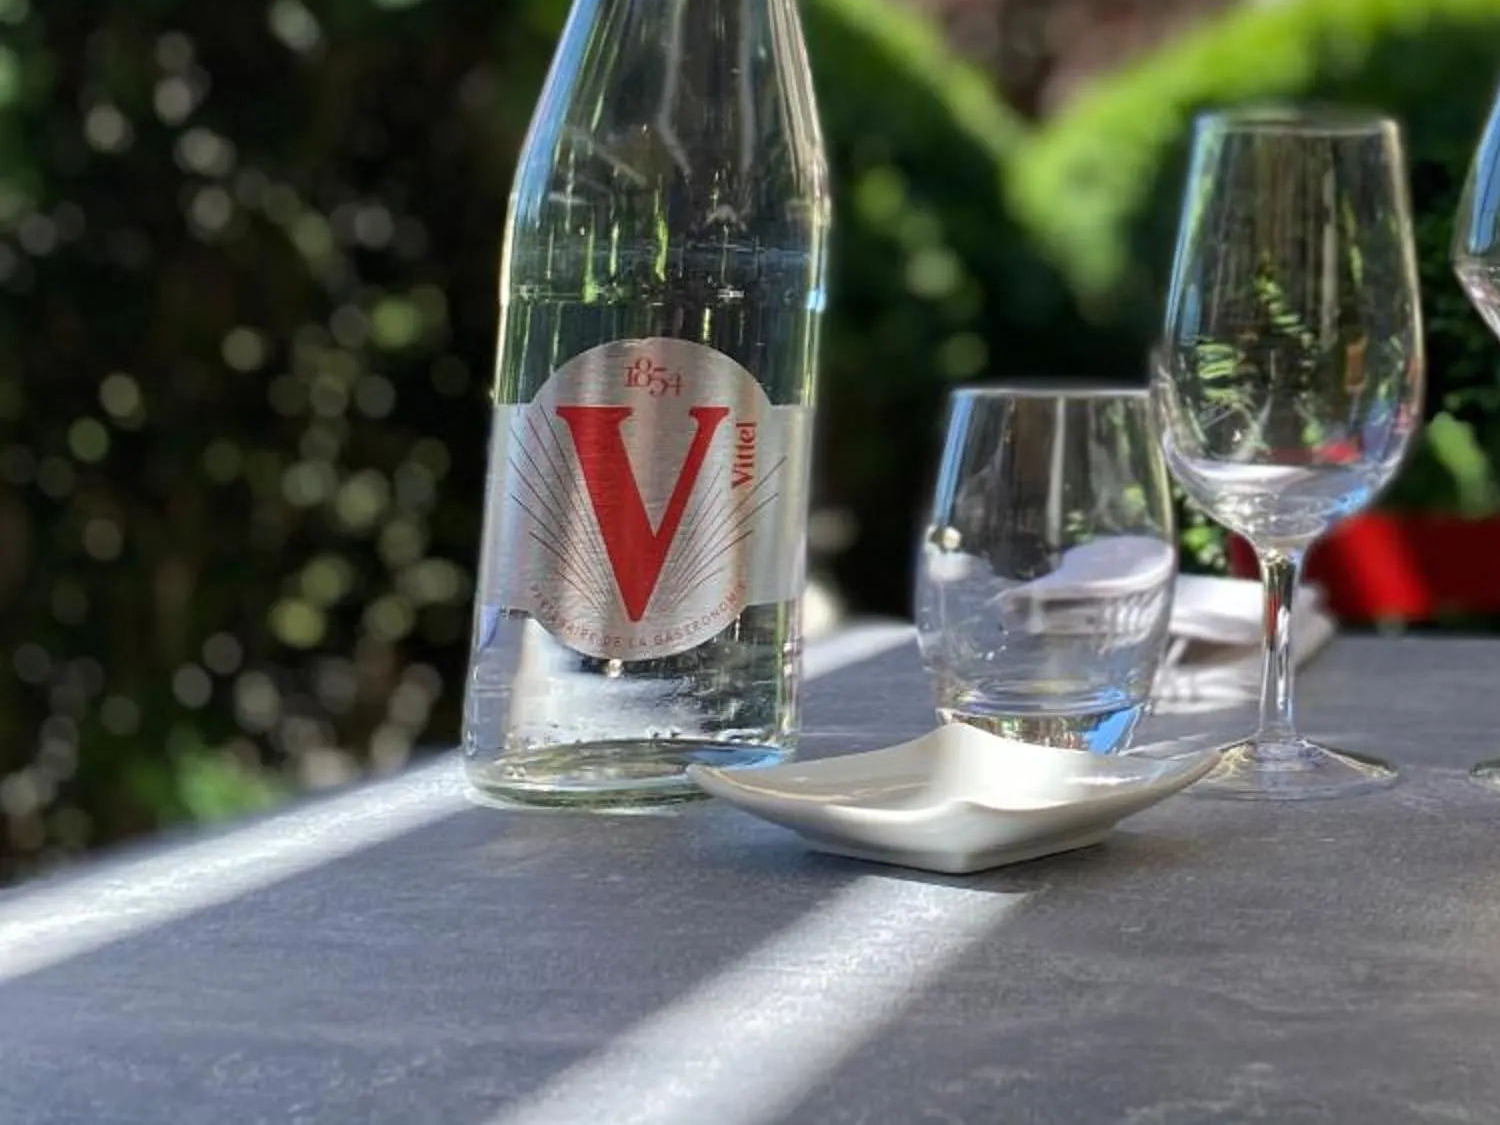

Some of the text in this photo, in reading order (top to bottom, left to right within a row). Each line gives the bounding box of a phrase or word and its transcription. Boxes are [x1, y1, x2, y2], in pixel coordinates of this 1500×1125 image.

[624, 358, 684, 397] 1854
[731, 422, 757, 490] Vittel
[555, 406, 729, 621] V
